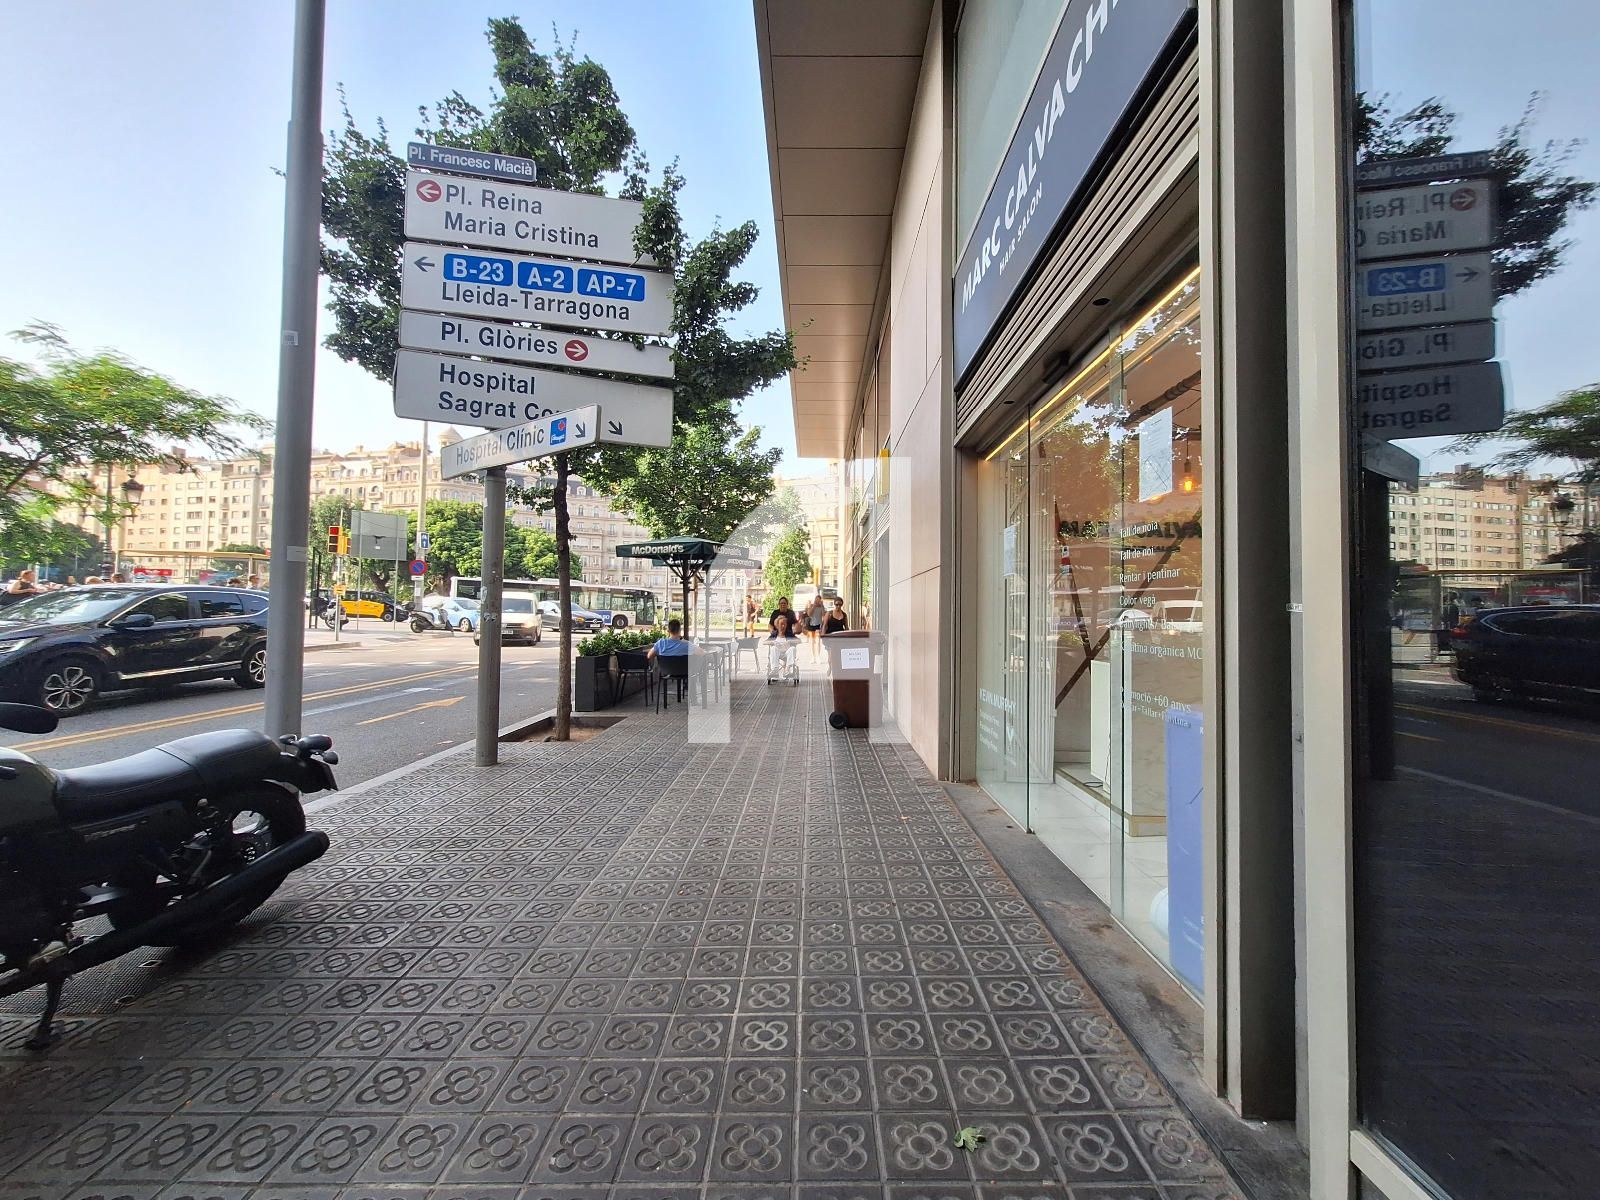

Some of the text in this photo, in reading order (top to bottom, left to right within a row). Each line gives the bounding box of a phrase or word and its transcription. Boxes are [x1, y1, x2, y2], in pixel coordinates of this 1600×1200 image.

[408, 145, 533, 177] Pl. Francesc Macià
[962, 0, 1119, 313] MARC CALVACH
[446, 183, 542, 215] Pl. Reina
[444, 210, 599, 249] Maria Cristina
[999, 181, 1042, 276] HAIR SALON
[452, 258, 637, 297] B-23 A-2 AP-7
[441, 281, 630, 321] Lleida-Tarragona
[441, 321, 558, 355] Pl. Glòries
[439, 362, 535, 395] Hospital
[438, 390, 516, 419] Sagrat
[456, 425, 545, 466] Hospital Clínic
[631, 543, 684, 555] McDonald's
[1119, 572, 1141, 584] Rentar
[1147, 567, 1181, 583] pentinar
